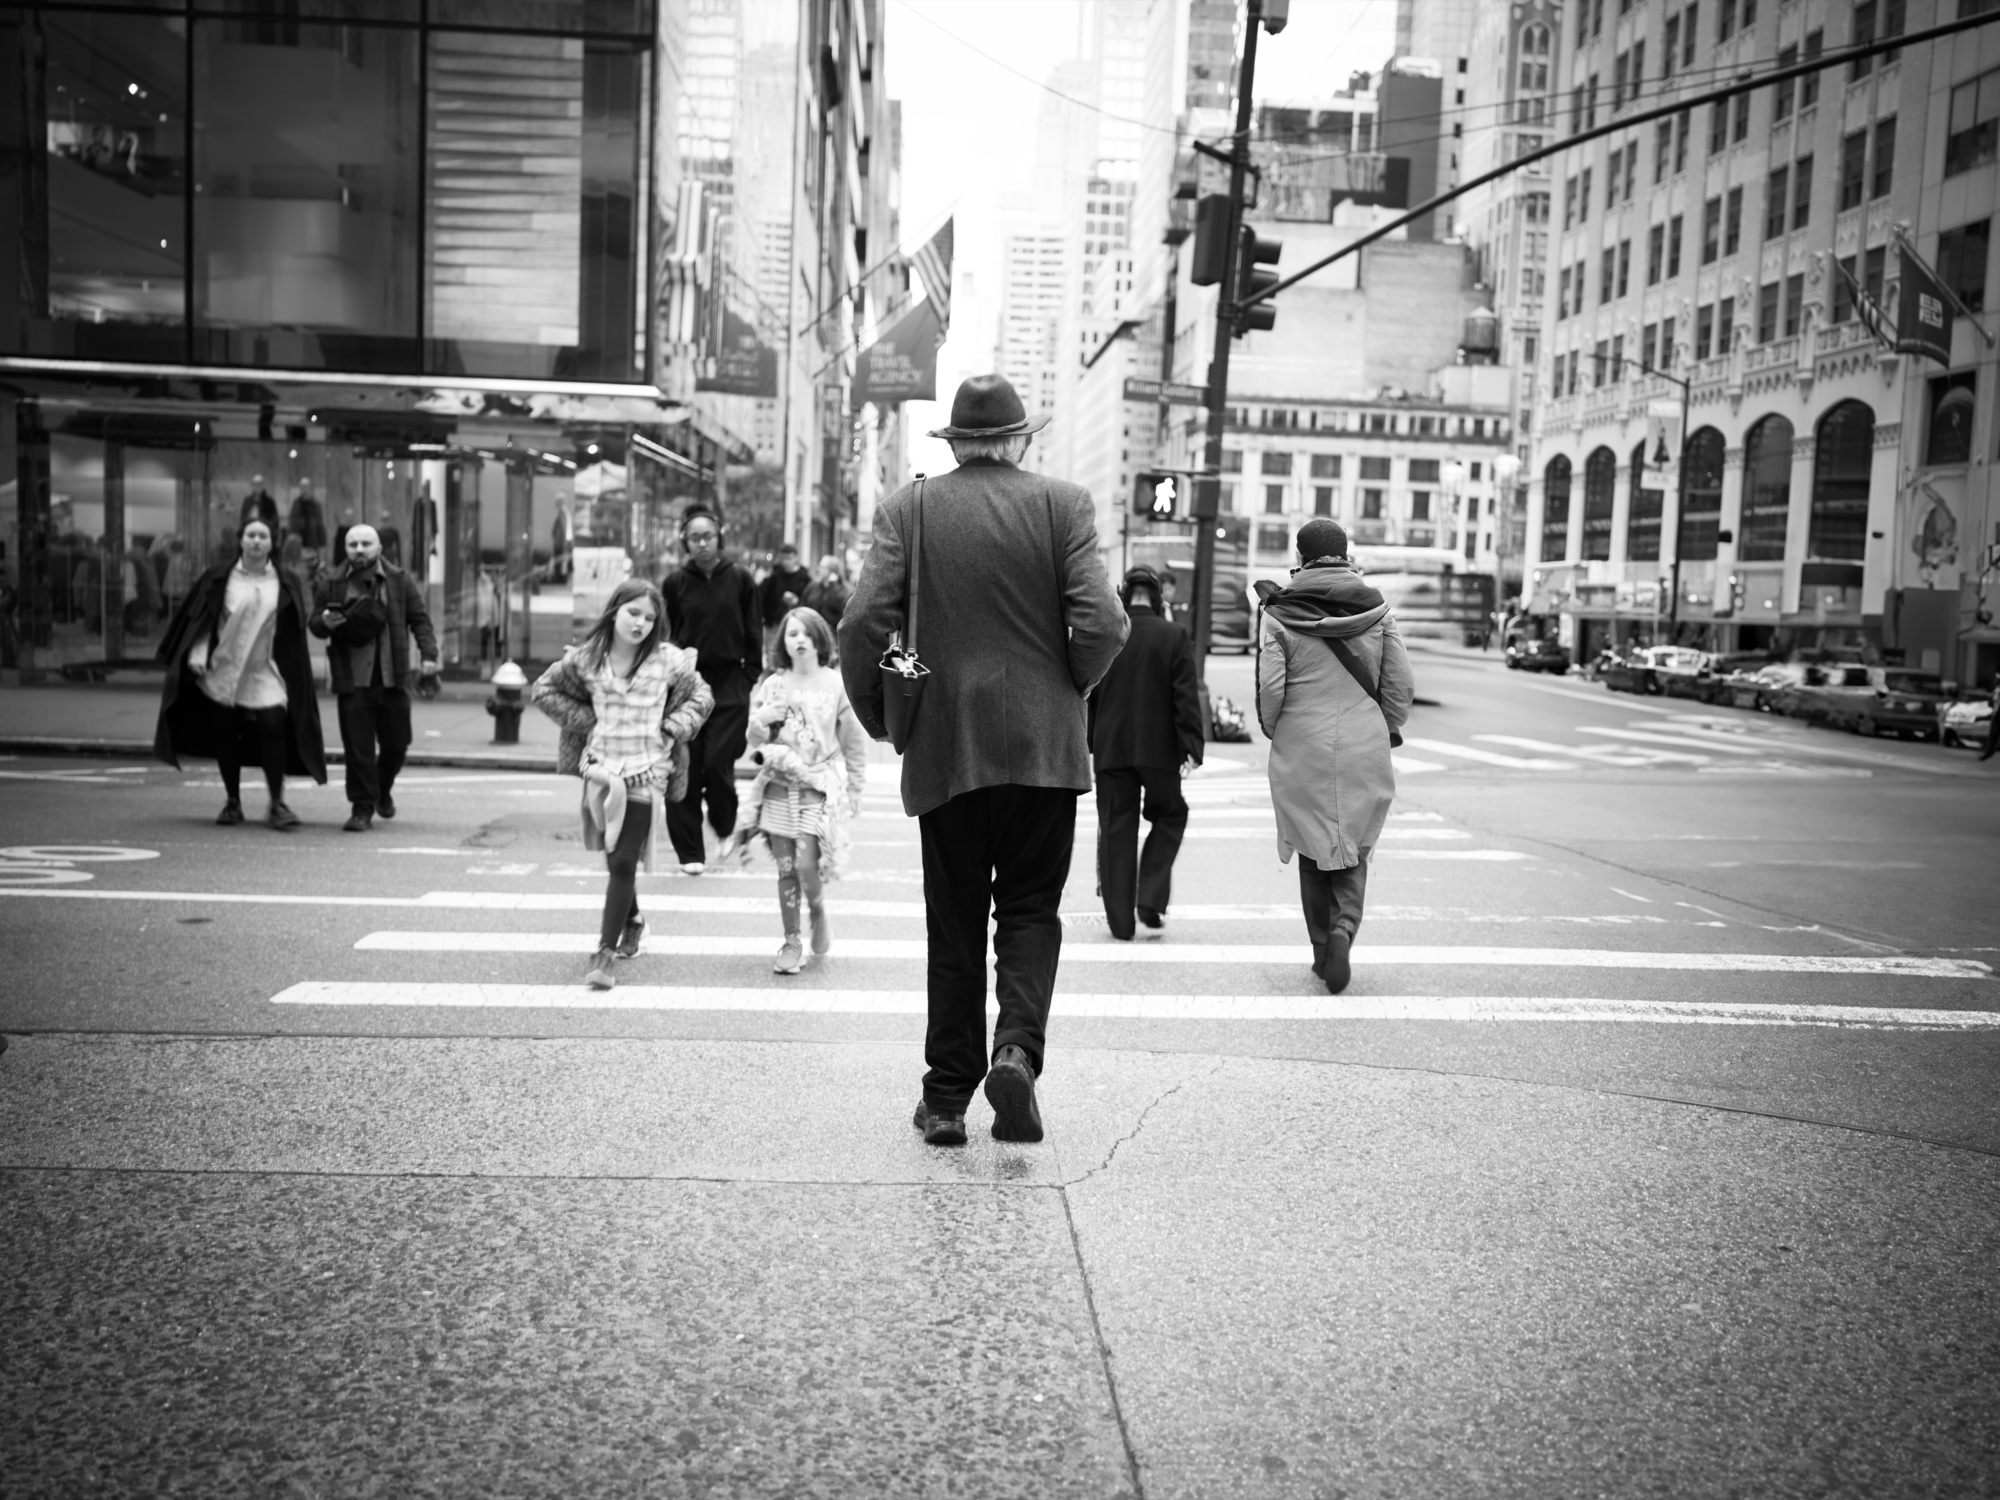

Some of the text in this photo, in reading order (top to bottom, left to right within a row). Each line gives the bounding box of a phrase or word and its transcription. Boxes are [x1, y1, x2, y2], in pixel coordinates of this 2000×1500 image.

[867, 369, 923, 384] AGENCY
[1127, 382, 1203, 401] William Goldberg
